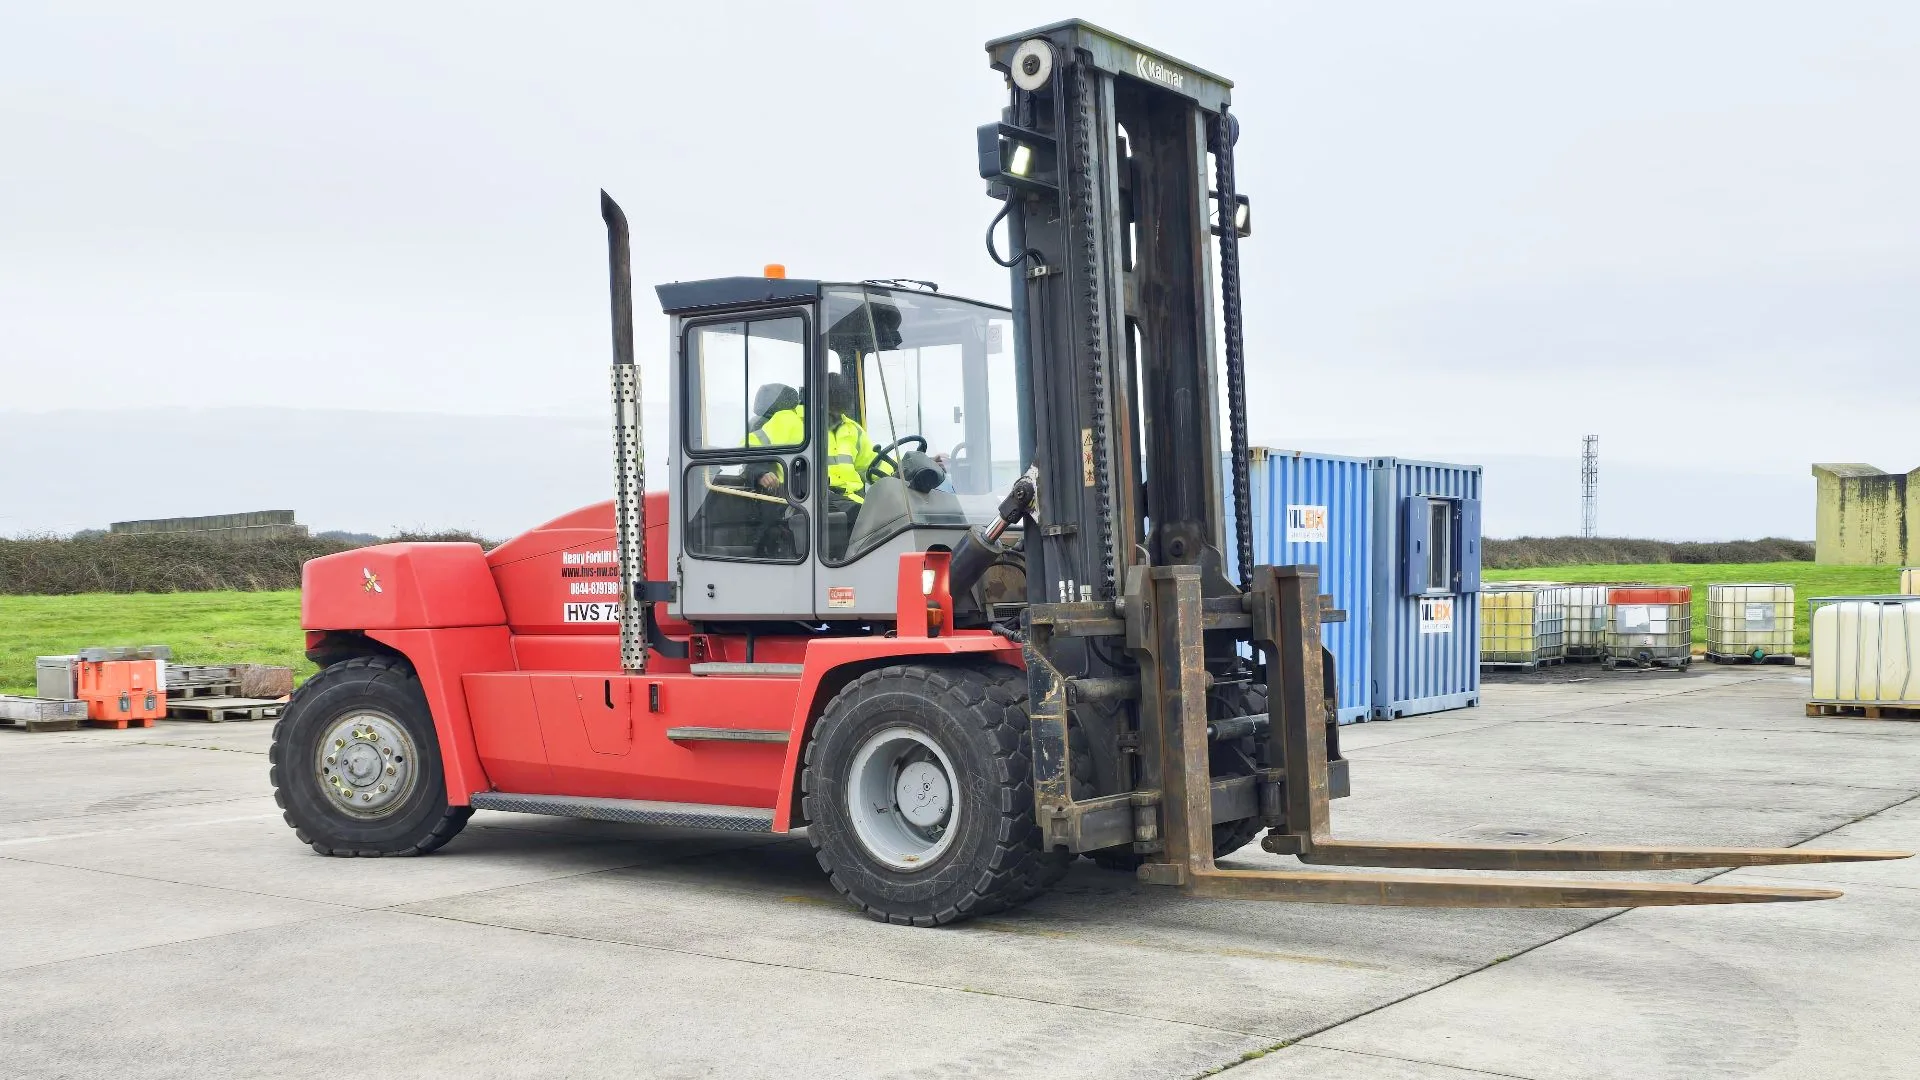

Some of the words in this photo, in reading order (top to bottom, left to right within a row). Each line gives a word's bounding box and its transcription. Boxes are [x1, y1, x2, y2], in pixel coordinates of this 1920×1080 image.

[1148, 60, 1184, 88] Kalmar
[562, 551, 585, 565] Heavy
[586, 549, 612, 564] Forklift
[567, 603, 600, 621] HVS
